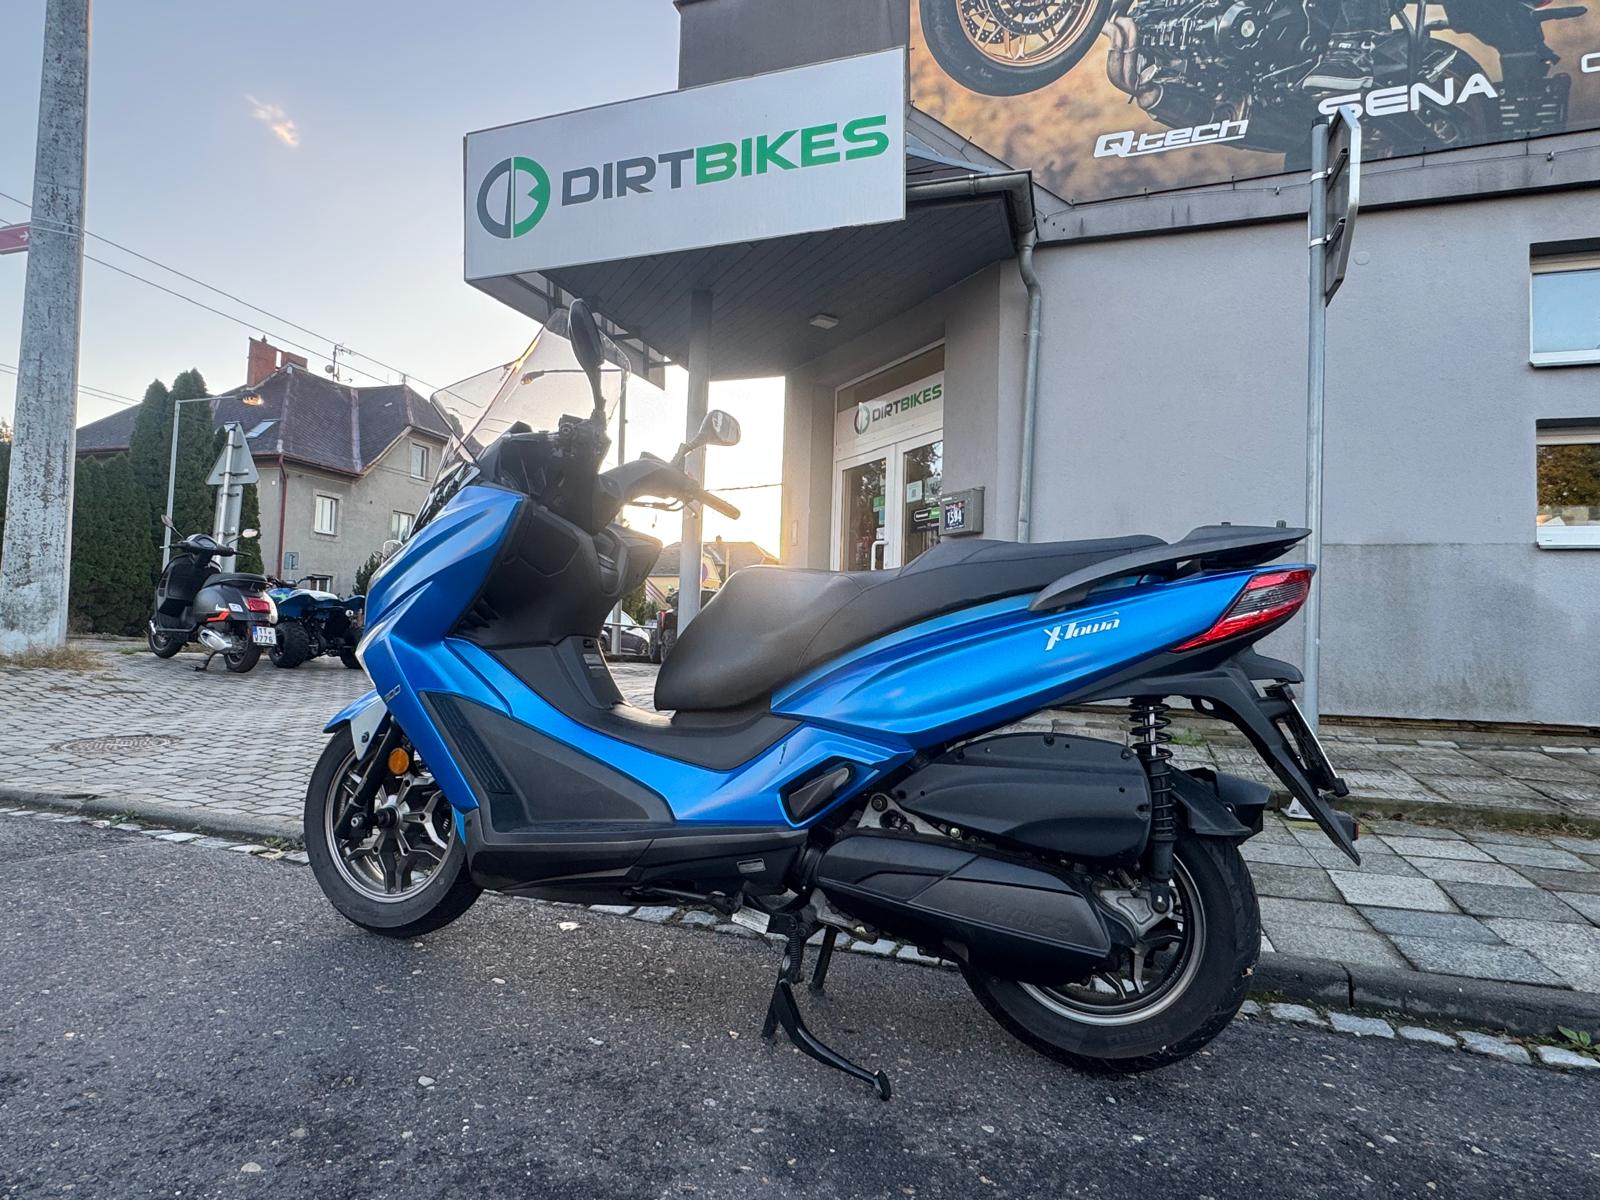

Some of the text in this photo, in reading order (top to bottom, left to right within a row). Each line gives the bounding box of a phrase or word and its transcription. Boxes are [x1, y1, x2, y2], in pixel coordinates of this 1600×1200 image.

[1318, 73, 1498, 119] SENA
[1094, 119, 1249, 158] Q-tech
[561, 115, 889, 206] DIRTBIKES
[872, 383, 942, 422] DIRTBIKES
